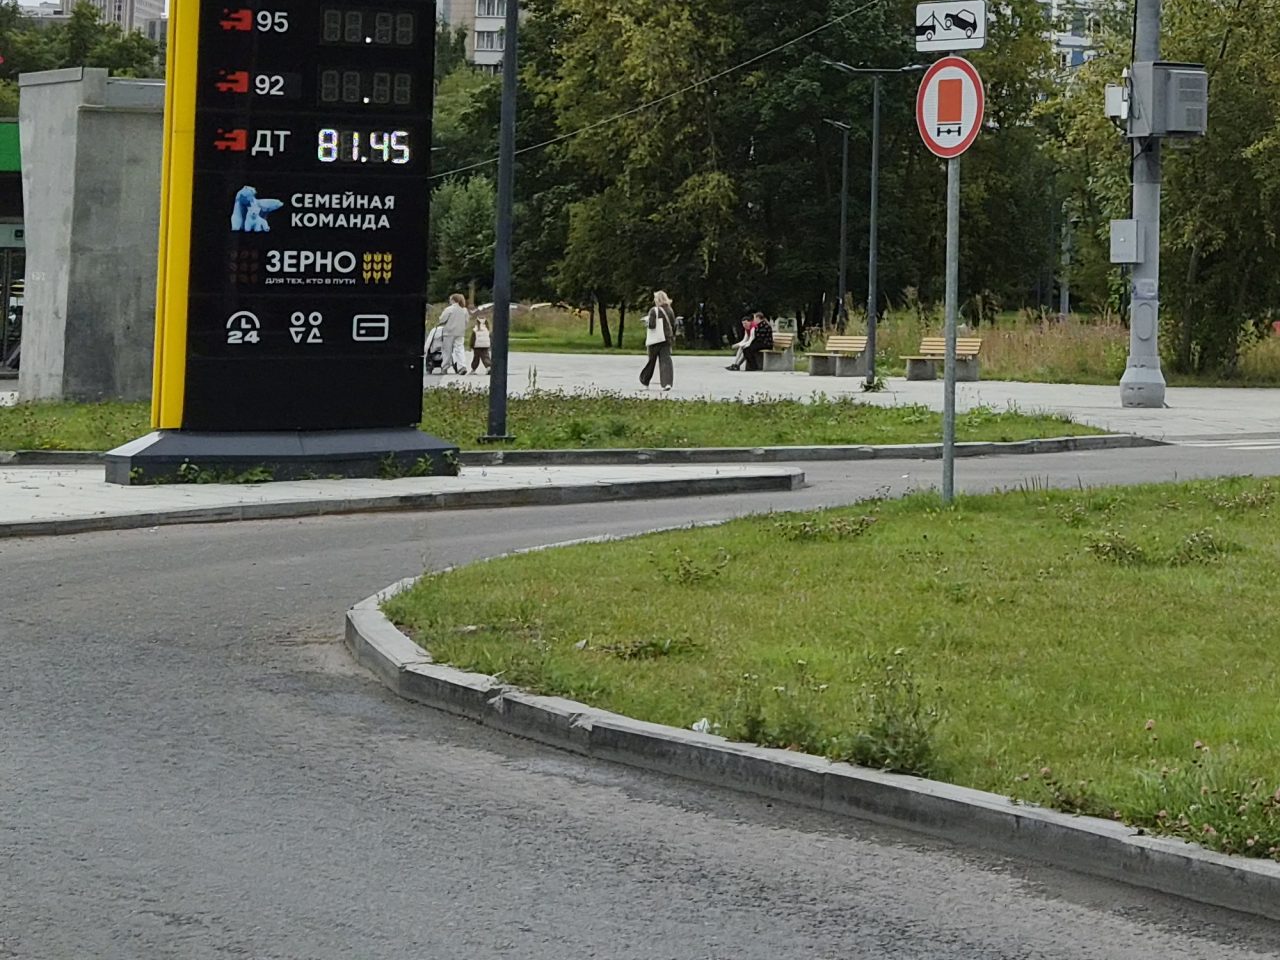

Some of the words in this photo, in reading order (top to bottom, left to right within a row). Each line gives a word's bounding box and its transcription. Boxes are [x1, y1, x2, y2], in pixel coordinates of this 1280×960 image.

[257, 11, 289, 33] 95
[255, 75, 284, 96] 92
[252, 130, 291, 156] ДТ
[317, 128, 410, 164] 81.45
[291, 192, 395, 210] СЕМЕЙНАЯ
[291, 213, 391, 231] КОМАНДА
[265, 250, 357, 274] ЗЕРНО
[227, 330, 260, 344] 24
